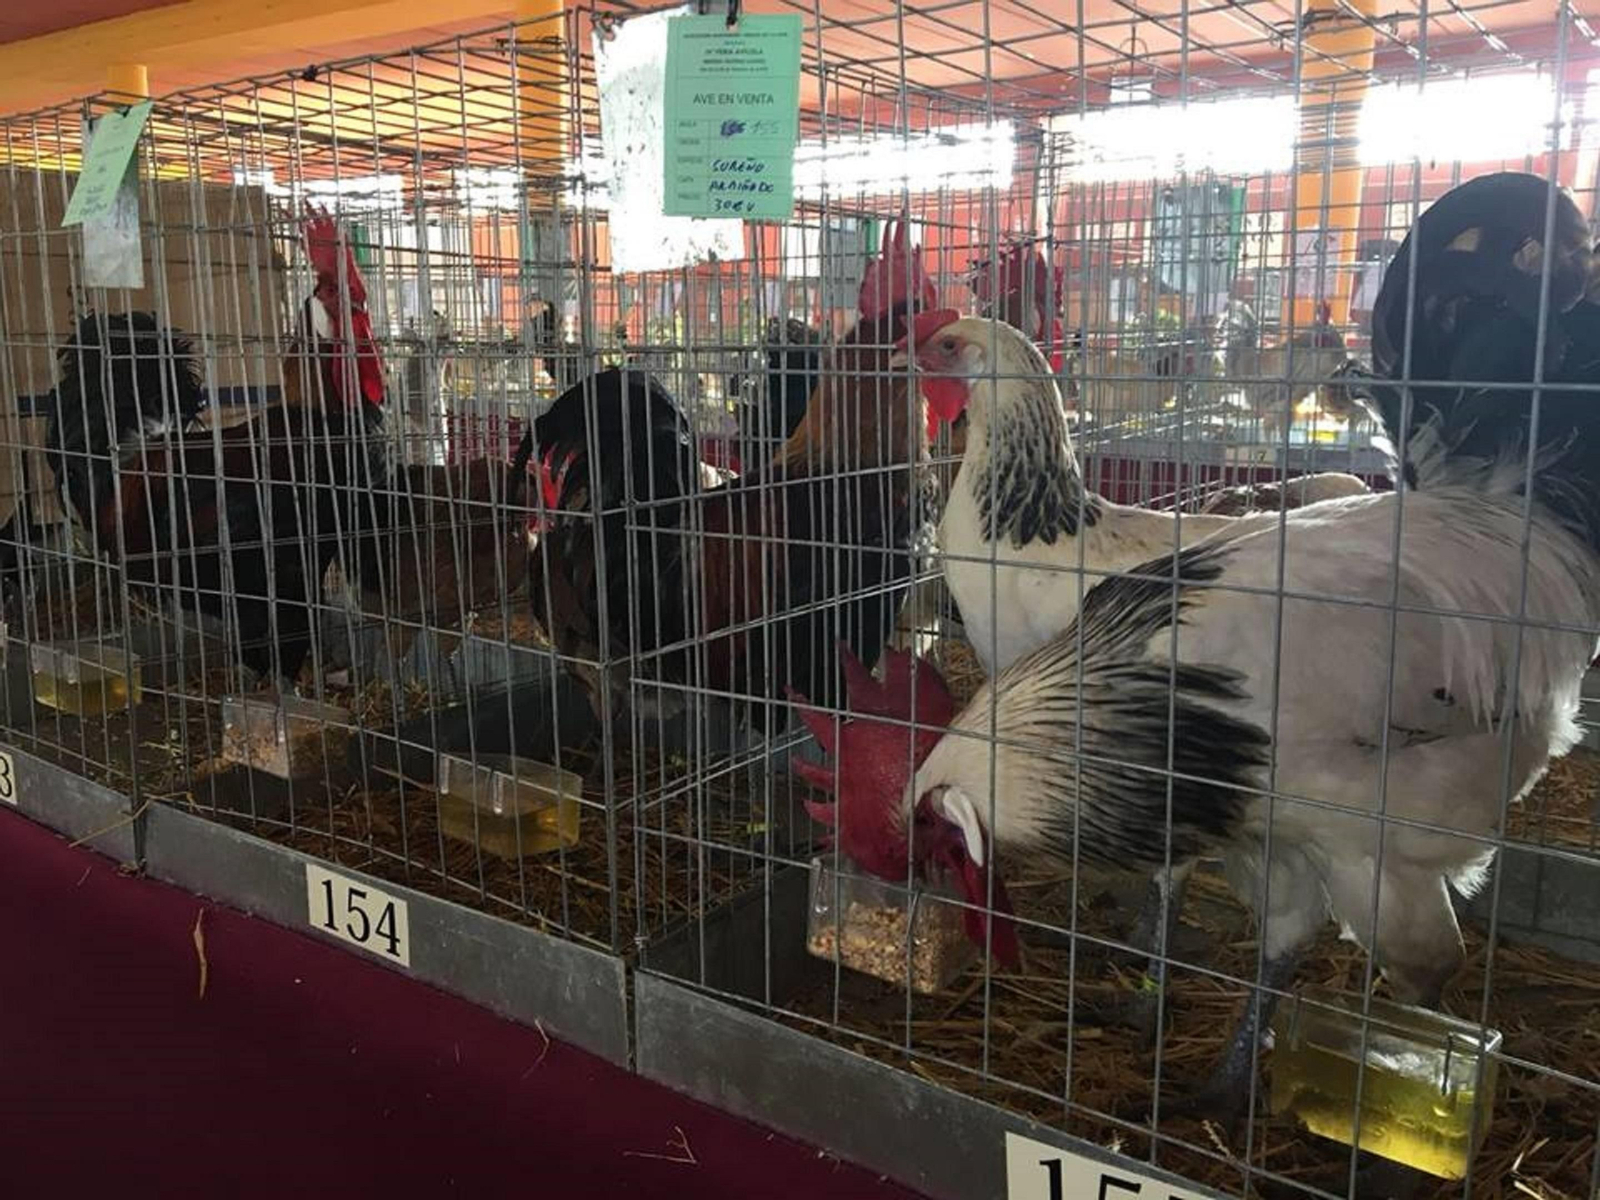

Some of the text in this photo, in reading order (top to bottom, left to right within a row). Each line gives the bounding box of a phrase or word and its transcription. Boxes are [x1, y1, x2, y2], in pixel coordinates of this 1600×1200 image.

[693, 93, 774, 105] AVE EN VENTA
[712, 157, 765, 173] SUREÑO
[321, 879, 400, 957] 154
